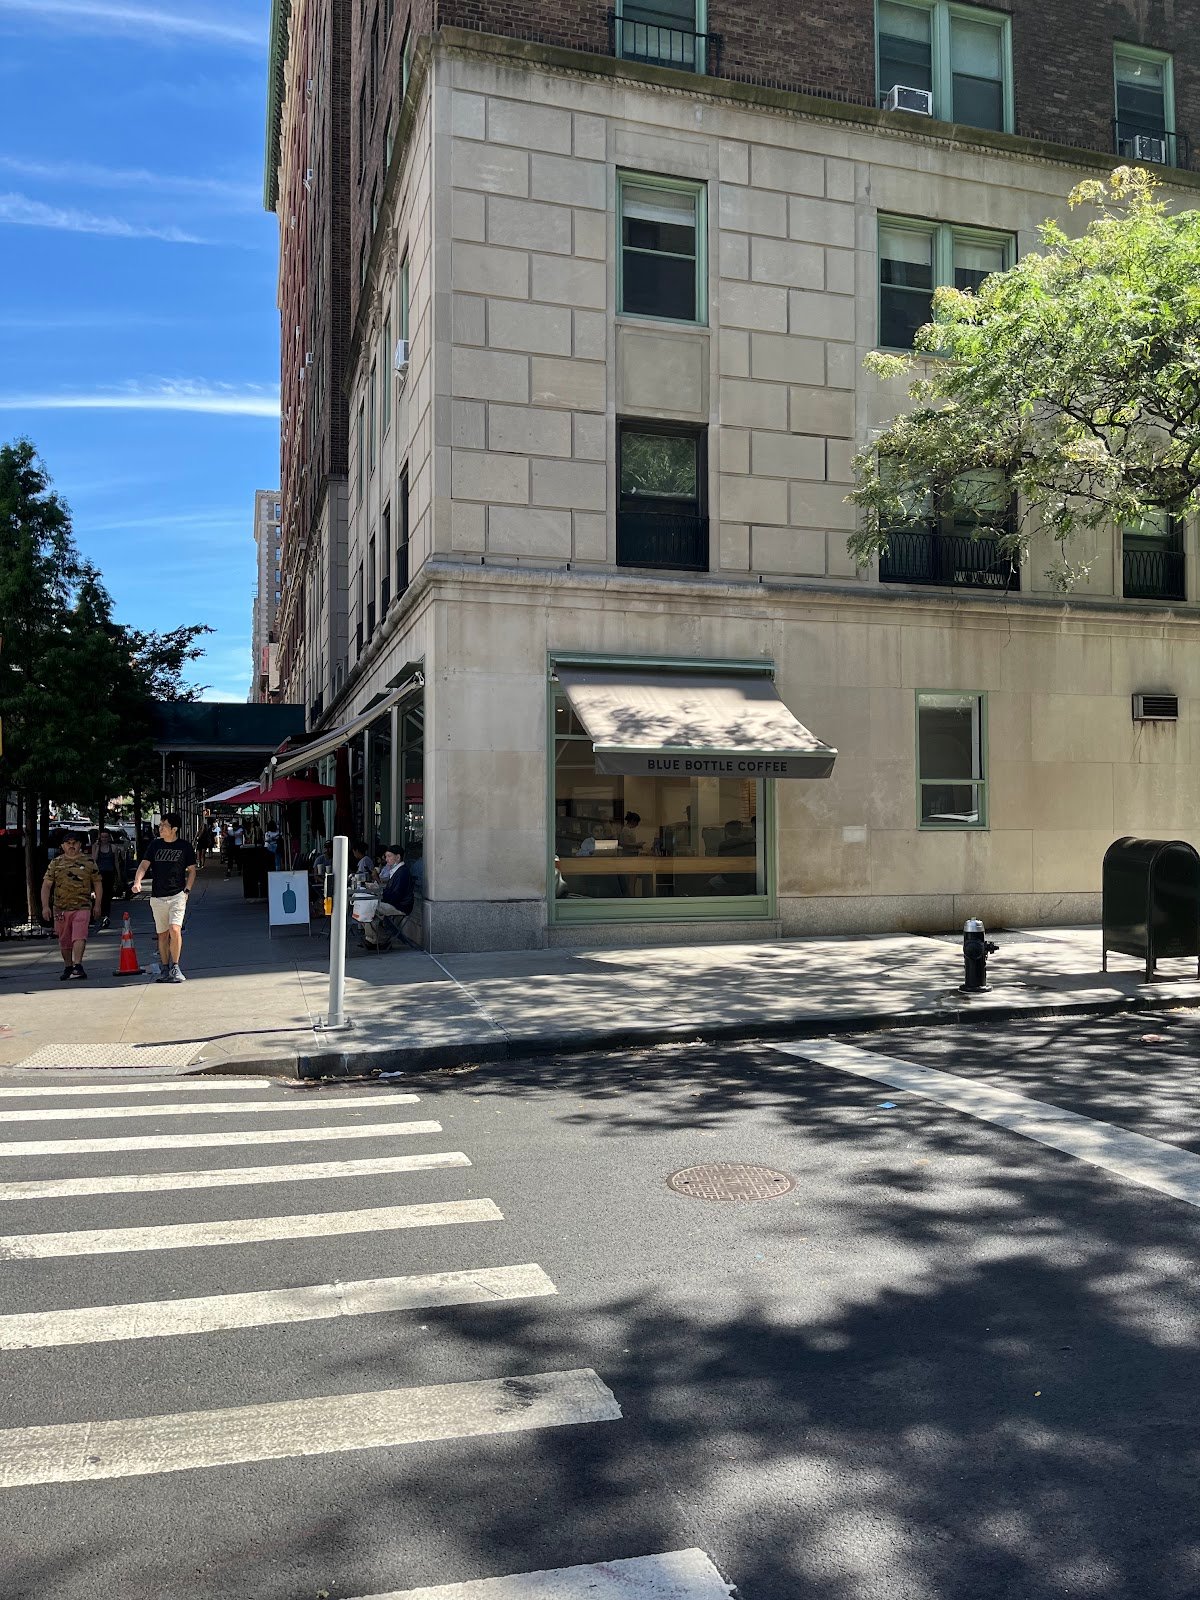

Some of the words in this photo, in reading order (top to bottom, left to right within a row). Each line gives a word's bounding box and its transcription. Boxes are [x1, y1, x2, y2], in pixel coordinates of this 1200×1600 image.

[647, 759, 680, 770] BLUE
[685, 760, 733, 772] BOTTLE
[737, 761, 788, 772] COFFEE
[155, 848, 183, 862] NIKE
